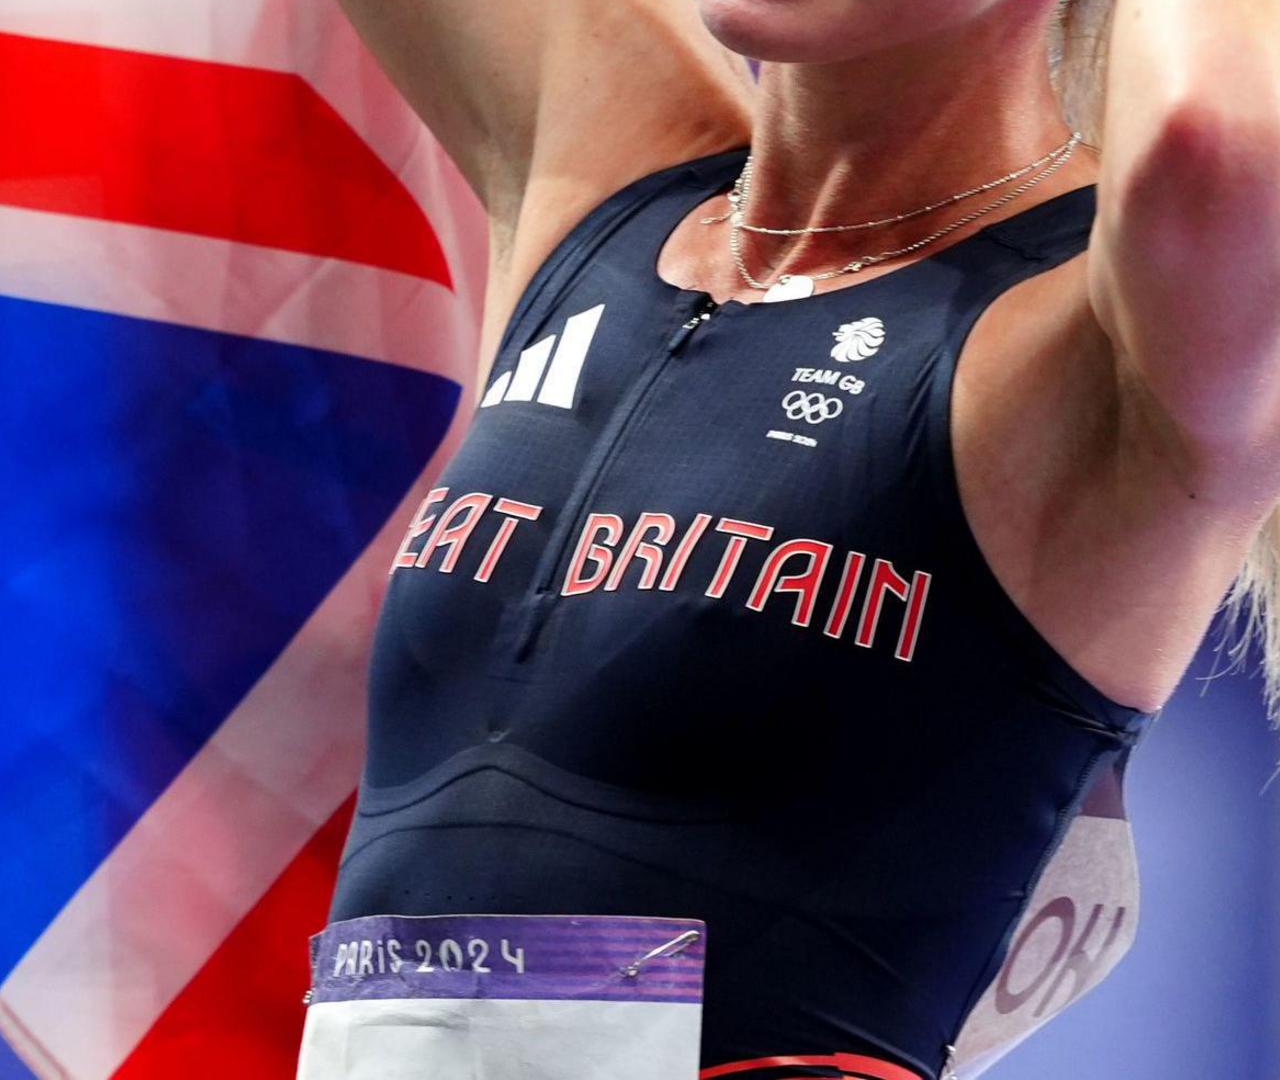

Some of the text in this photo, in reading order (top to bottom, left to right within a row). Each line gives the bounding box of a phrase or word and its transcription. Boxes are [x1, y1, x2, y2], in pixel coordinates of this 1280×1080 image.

[791, 368, 865, 395] TEAM GB
[389, 487, 932, 662] EAT BRITAIN
[416, 938, 524, 974] 2024
